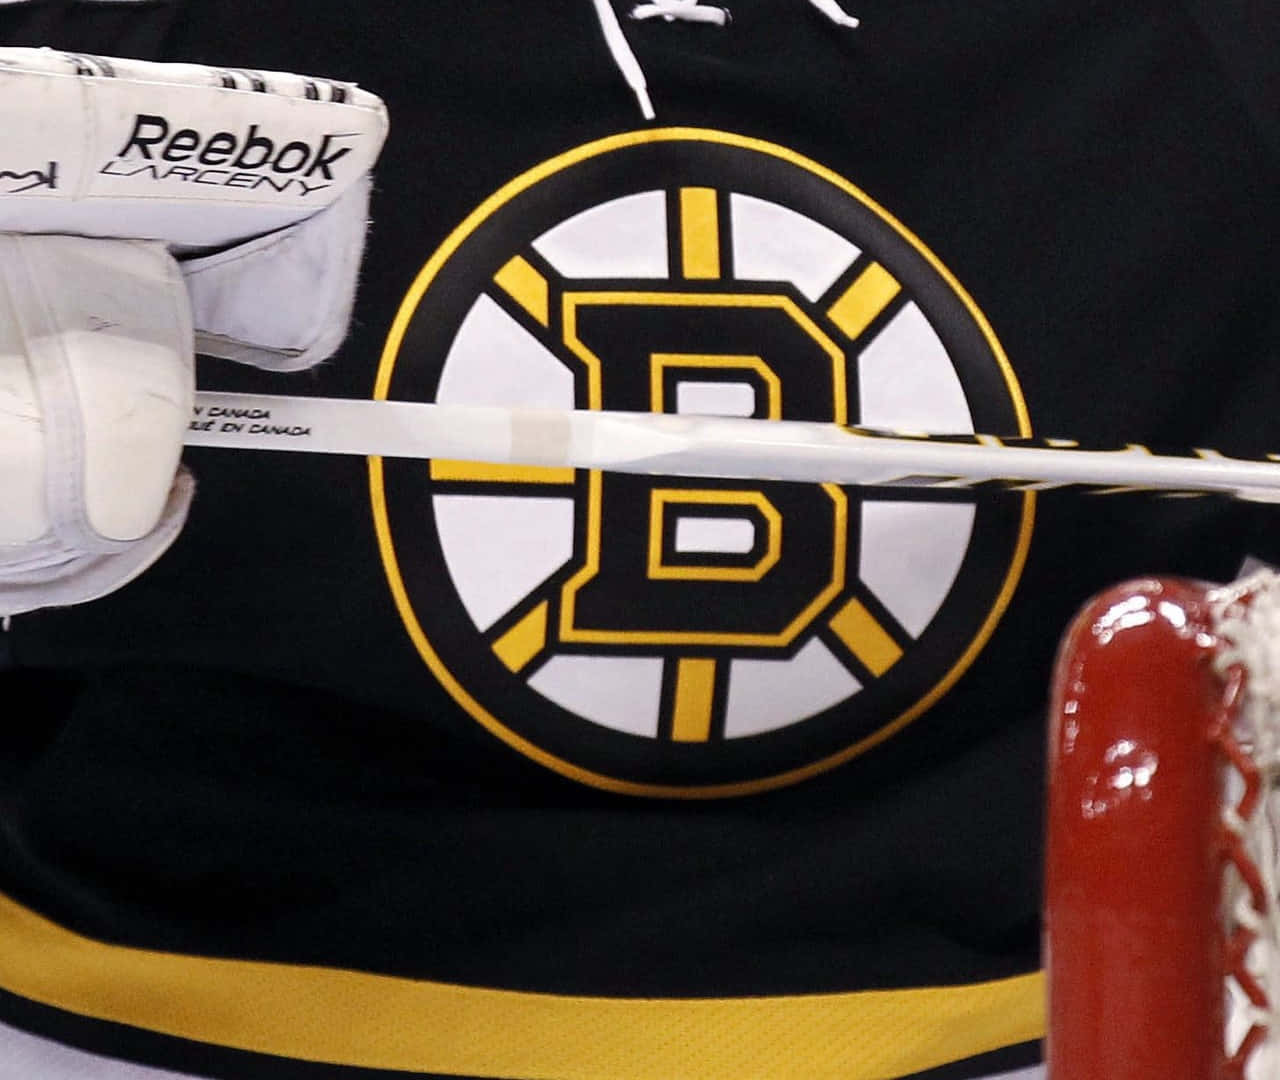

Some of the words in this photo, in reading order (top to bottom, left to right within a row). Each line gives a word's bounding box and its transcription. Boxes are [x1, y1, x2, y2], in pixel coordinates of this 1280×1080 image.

[117, 113, 363, 180] Reebok
[99, 160, 332, 197] LARCENY
[207, 407, 270, 419] CANADA
[220, 422, 244, 432] EN
[248, 423, 311, 436] CANADA
[560, 291, 848, 648] B
